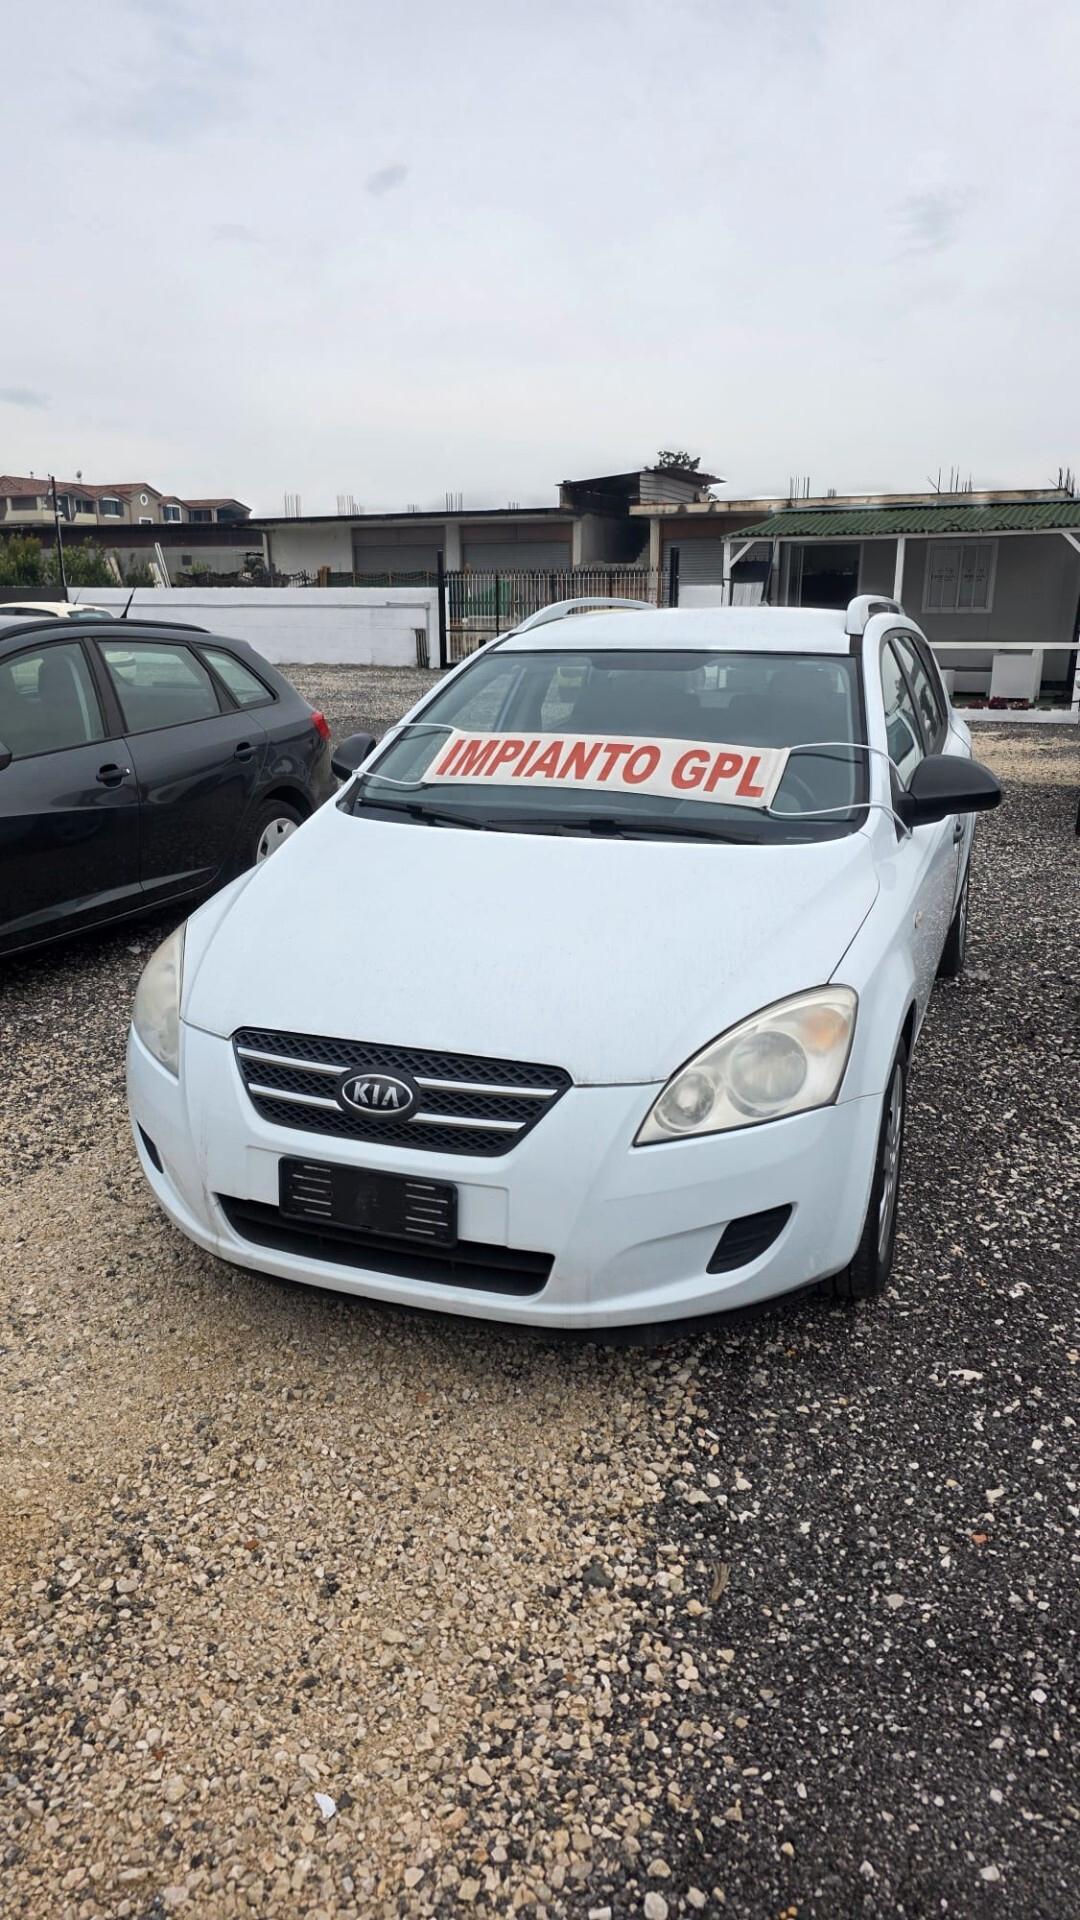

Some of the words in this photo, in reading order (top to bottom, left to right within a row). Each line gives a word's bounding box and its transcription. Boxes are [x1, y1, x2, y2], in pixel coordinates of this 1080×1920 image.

[437, 739, 661, 784] IMPIANTO
[671, 749, 764, 797] GPL
[353, 1081, 400, 1108] KIA
